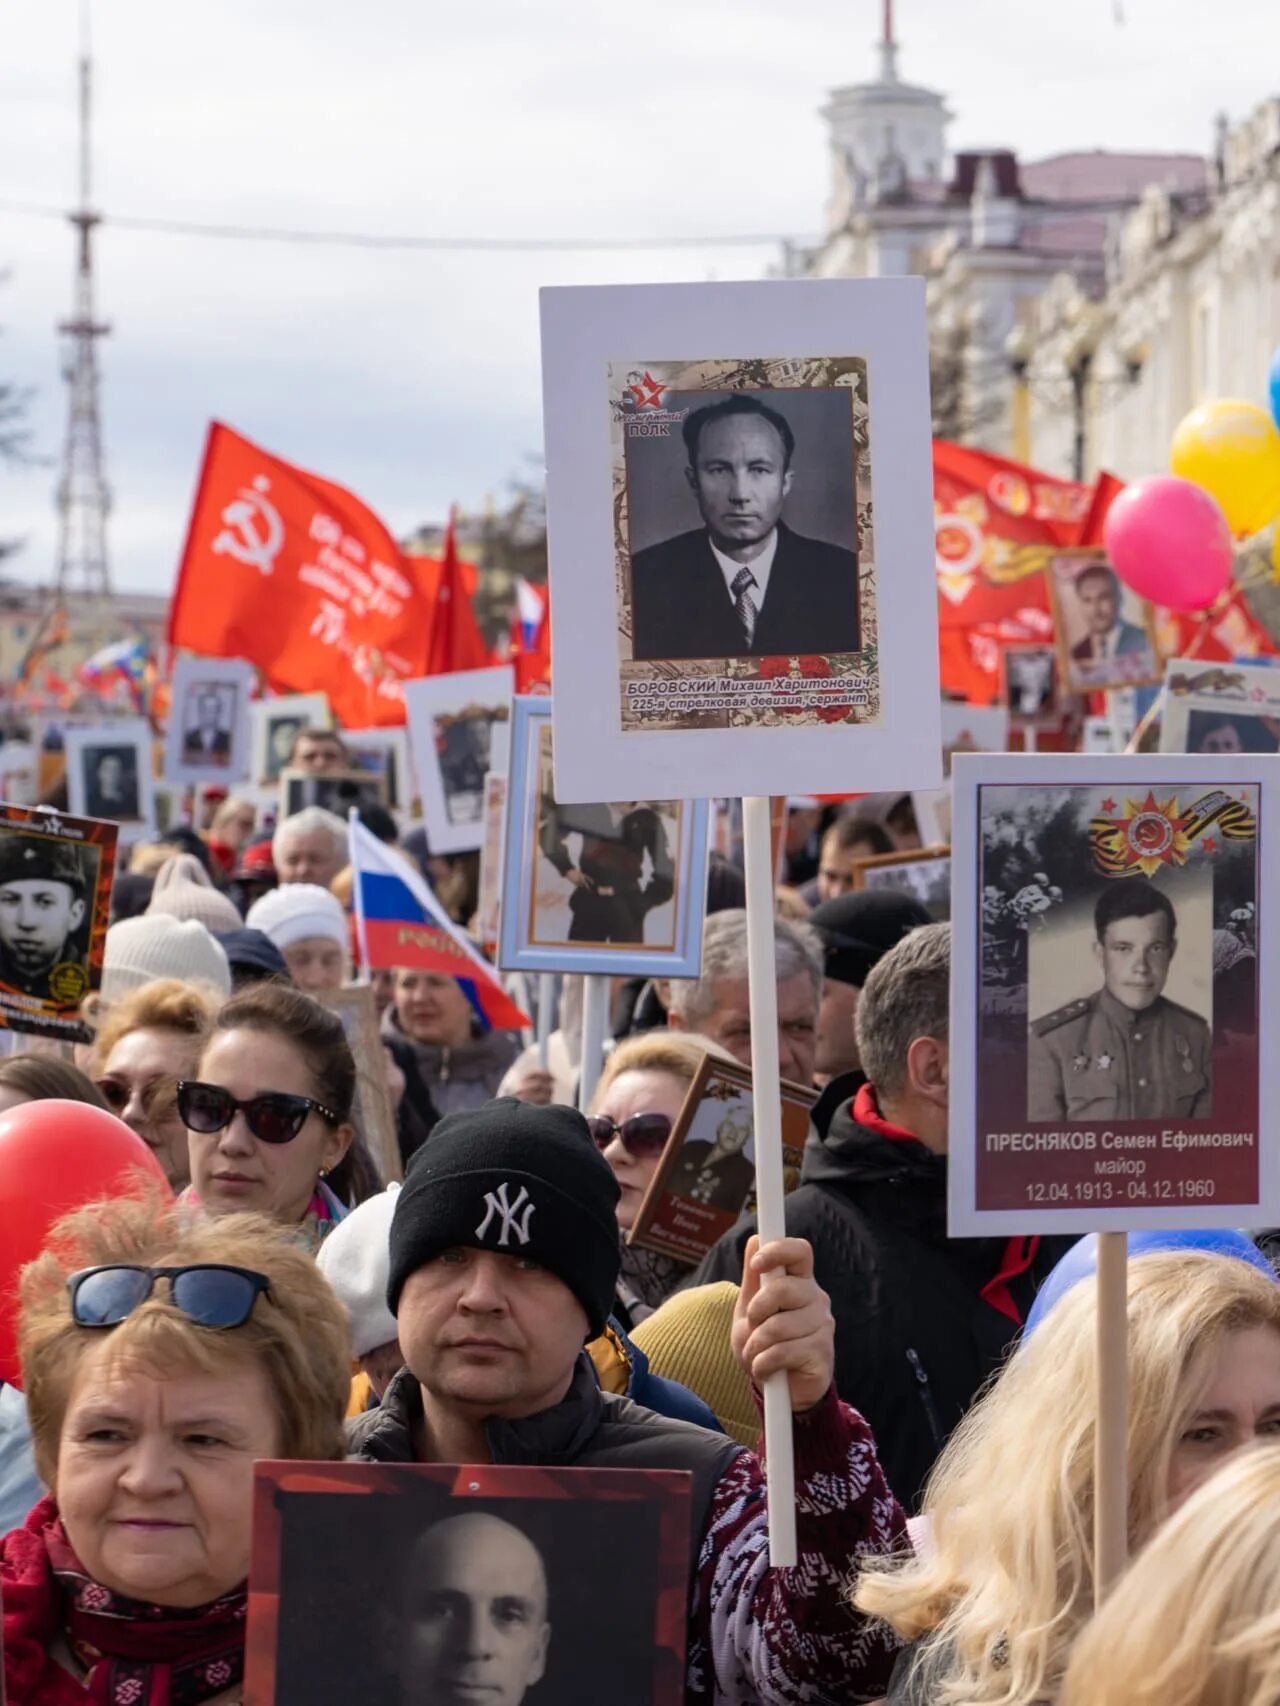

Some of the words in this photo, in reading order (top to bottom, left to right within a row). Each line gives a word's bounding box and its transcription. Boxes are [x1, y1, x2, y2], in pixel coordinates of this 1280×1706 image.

[629, 424, 671, 437] ПОЛК
[627, 680, 717, 695] БОРОВСКИЙ
[719, 679, 772, 692] Михаил
[774, 678, 870, 691] Харитонович
[632, 698, 665, 711] 225-я
[668, 695, 748, 711] стрелковая
[809, 693, 867, 708] сержант
[985, 1132, 1097, 1152] ПРЕСНЯКОВ
[1100, 1132, 1157, 1150] Семен
[1161, 1130, 1254, 1152] Ефимович
[1094, 1157, 1146, 1177] майор
[1025, 1182, 1113, 1201] 12.04.1913
[1127, 1179, 1215, 1199] 04.12.1960
[474, 1182, 536, 1245] NY
